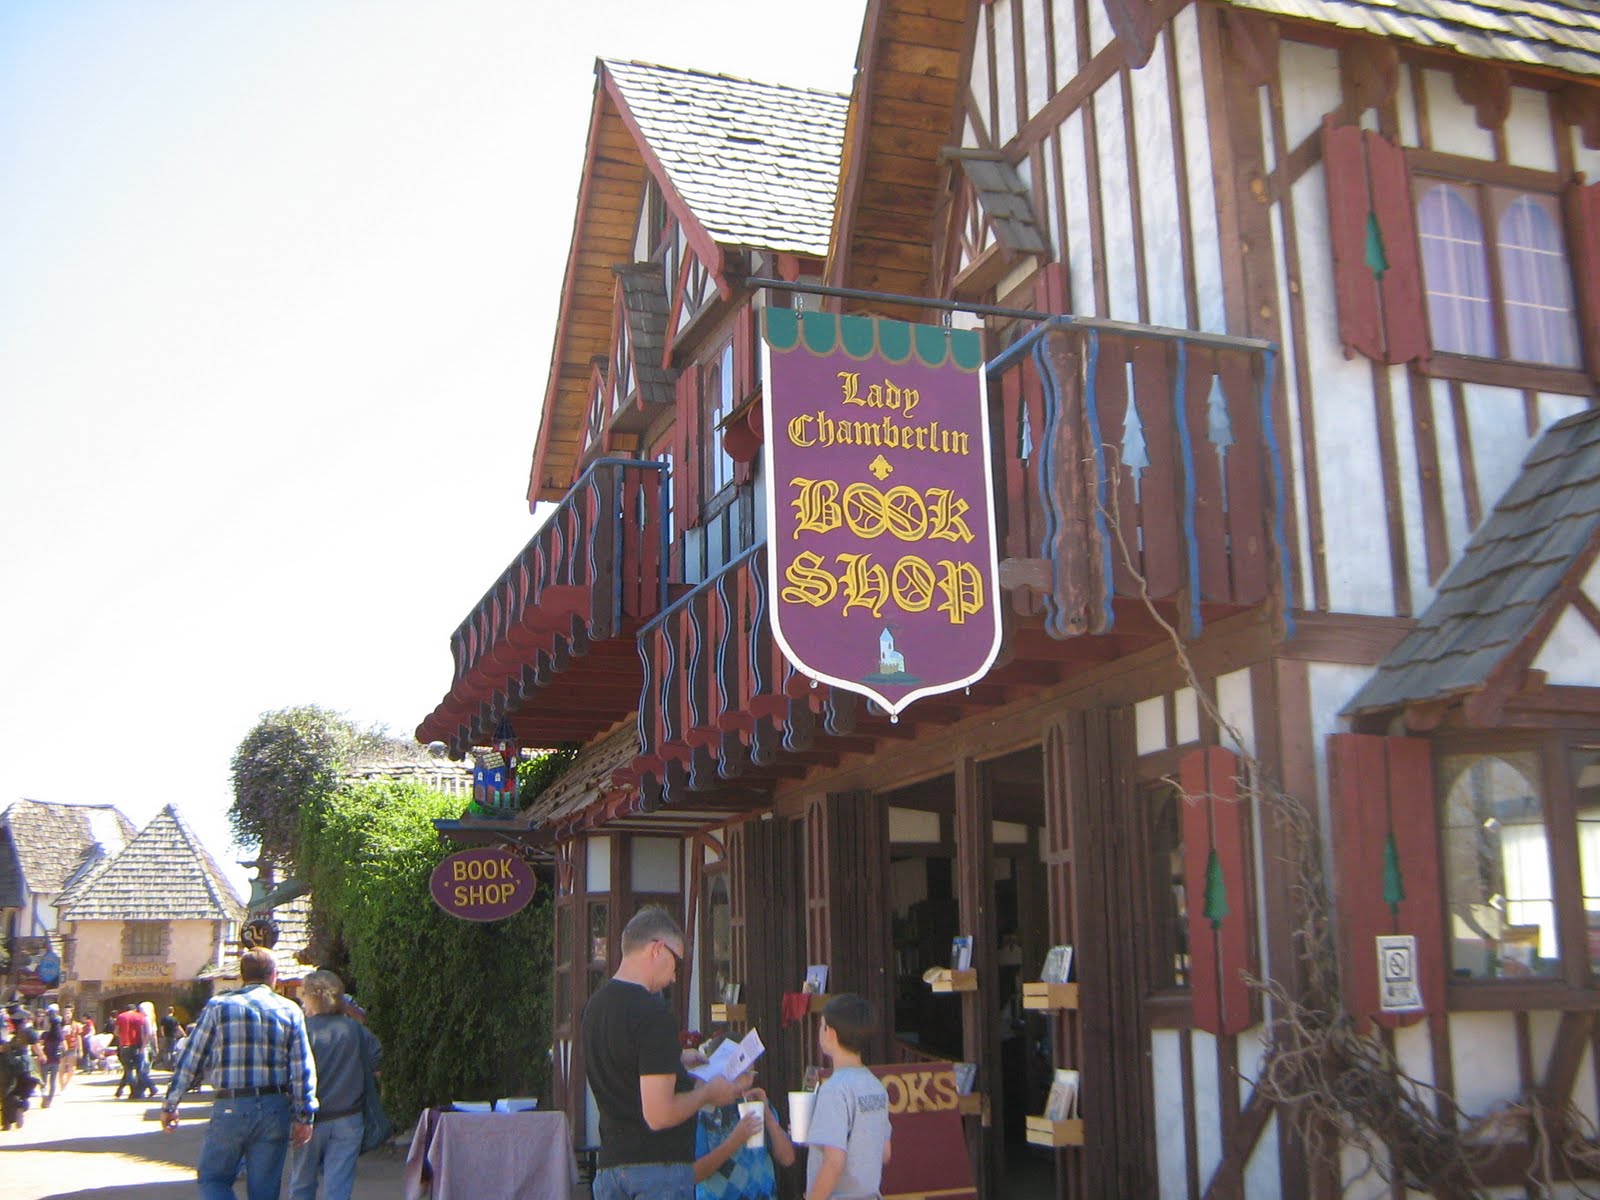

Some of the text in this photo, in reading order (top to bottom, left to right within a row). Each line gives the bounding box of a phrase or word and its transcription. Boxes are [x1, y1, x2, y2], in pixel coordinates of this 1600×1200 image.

[837, 371, 920, 419] Lady
[787, 410, 970, 456] Chamberlin
[788, 477, 976, 545] BOOK
[453, 858, 514, 881] BOOK
[454, 883, 515, 907] SHOP
[881, 1071, 959, 1114] OKS
